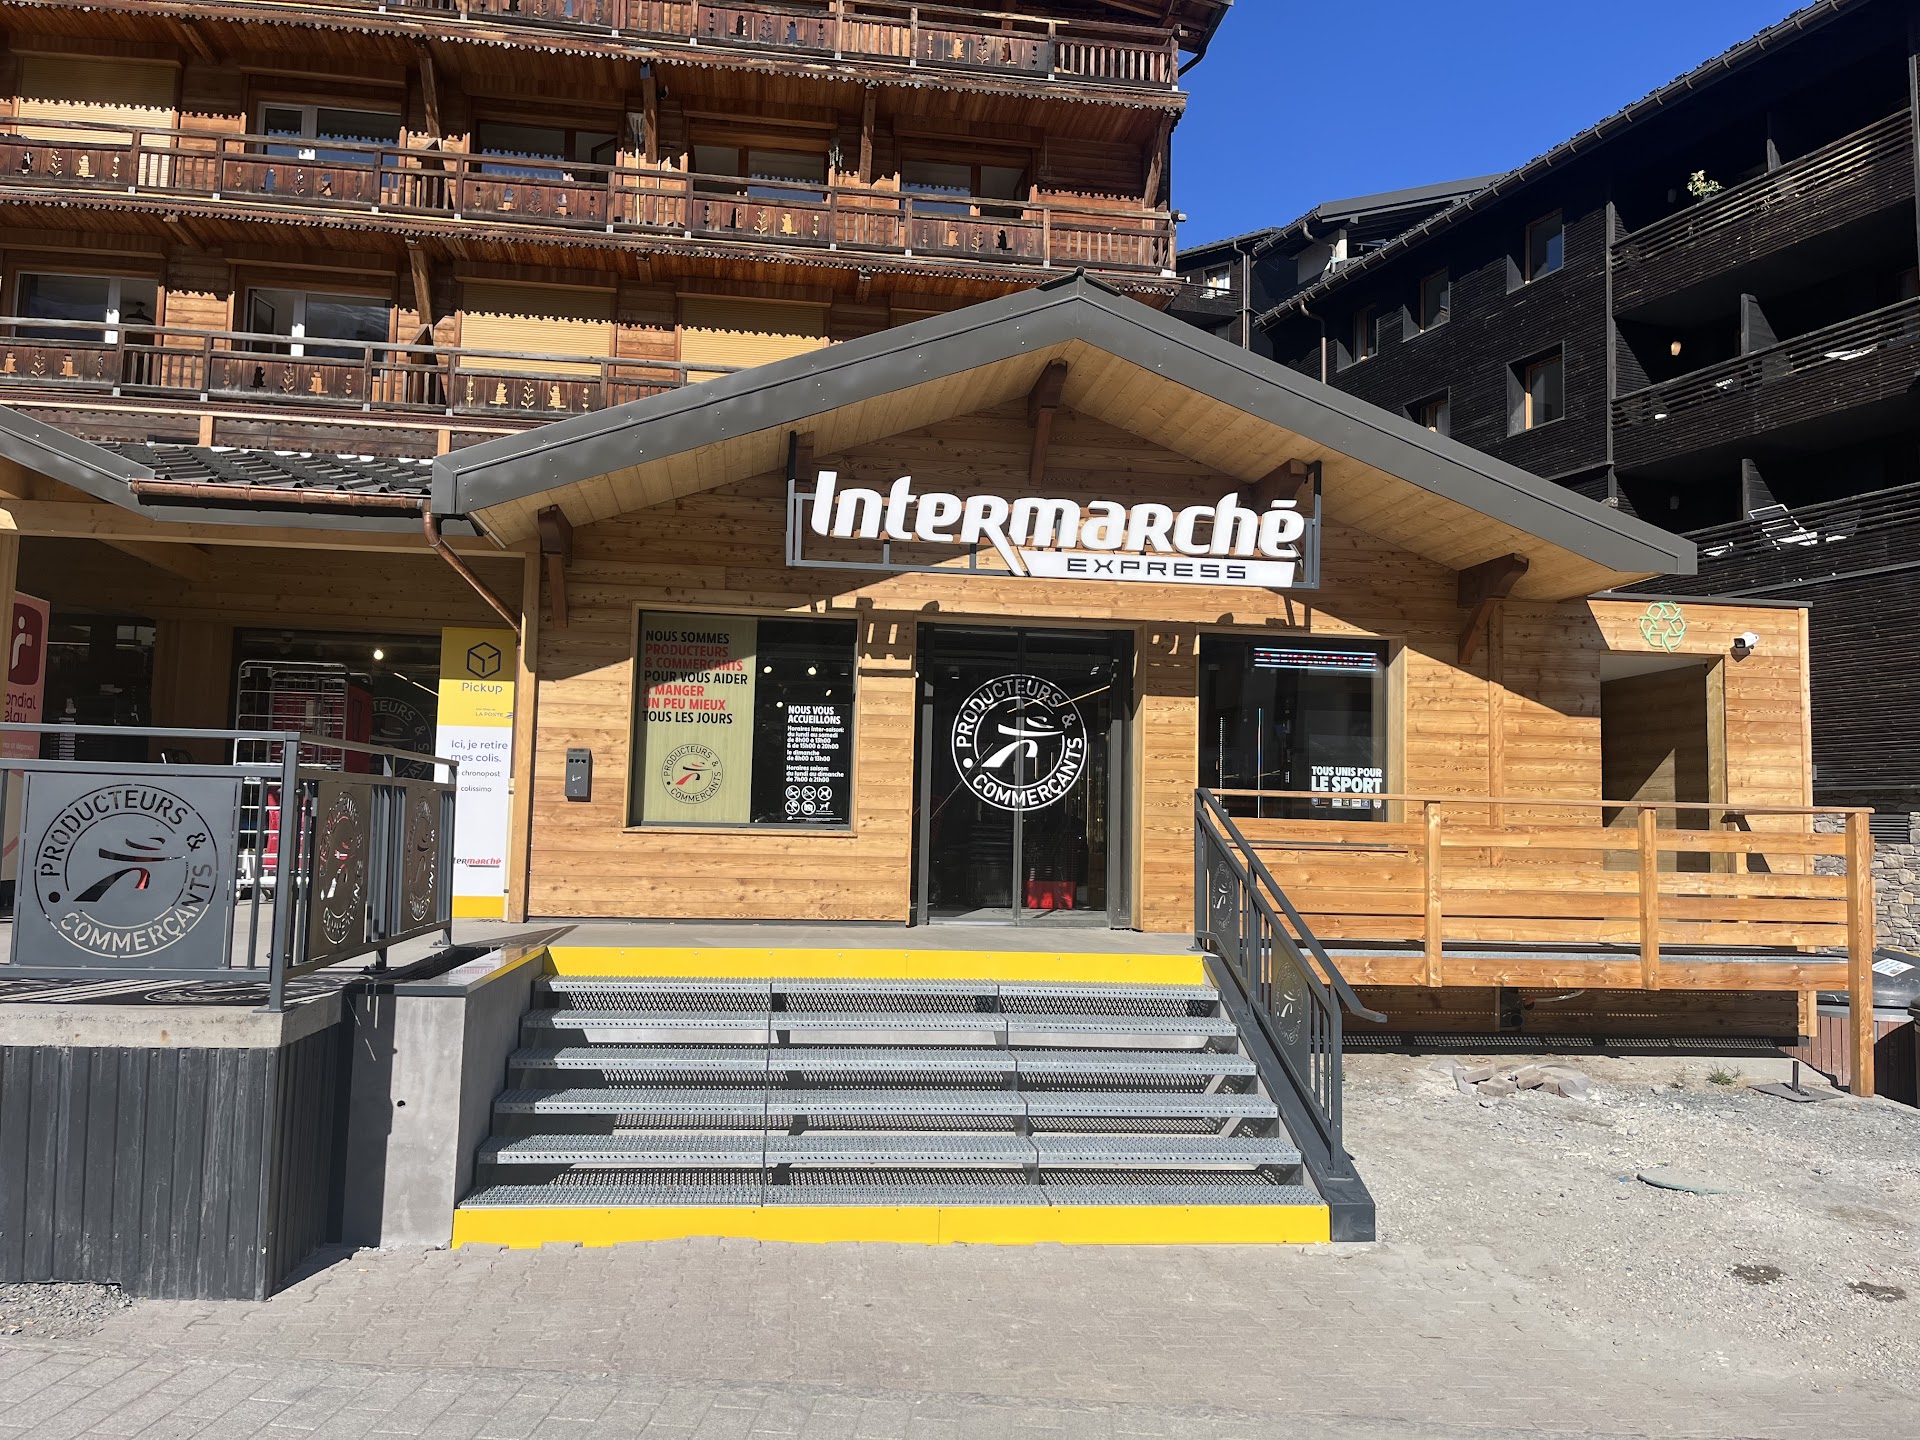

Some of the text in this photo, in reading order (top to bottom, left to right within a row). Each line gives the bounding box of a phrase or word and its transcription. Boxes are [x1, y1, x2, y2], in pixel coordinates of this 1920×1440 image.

[811, 470, 1304, 577] Intermarché
[1067, 557, 1246, 579] EXPRESS
[645, 630, 730, 644] NOUS SOMMES
[645, 643, 729, 658] PRODUCTEURS
[644, 657, 743, 672] & COMMERÇANTS
[644, 670, 748, 685] POUR VOUS AIDER
[461, 682, 503, 695] Pickup
[655, 684, 705, 696] MANGER
[5, 692, 36, 710] ondial
[643, 697, 726, 711] UN PEU MIEUX
[4, 707, 27, 723] elay
[642, 710, 733, 724] TOUS LES JOURS
[788, 705, 835, 715] NOUS VOUS
[956, 679, 1077, 747] PRODUCTEURS &
[787, 714, 841, 725] ACCUEILLONS
[451, 739, 508, 751] Ici, je retire
[450, 753, 502, 763] mes colis.
[664, 746, 712, 777] PRODUCTEURS
[461, 769, 501, 778] chronopost
[972, 737, 1083, 807] COMMERÇANTS
[1311, 766, 1383, 777] TOUS UNIS POUR
[460, 785, 492, 793] colissimo
[1311, 776, 1383, 793] LE SPORT
[41, 790, 207, 877] PRODUCTEURS &
[60, 864, 213, 952] COMMERÇANTS
